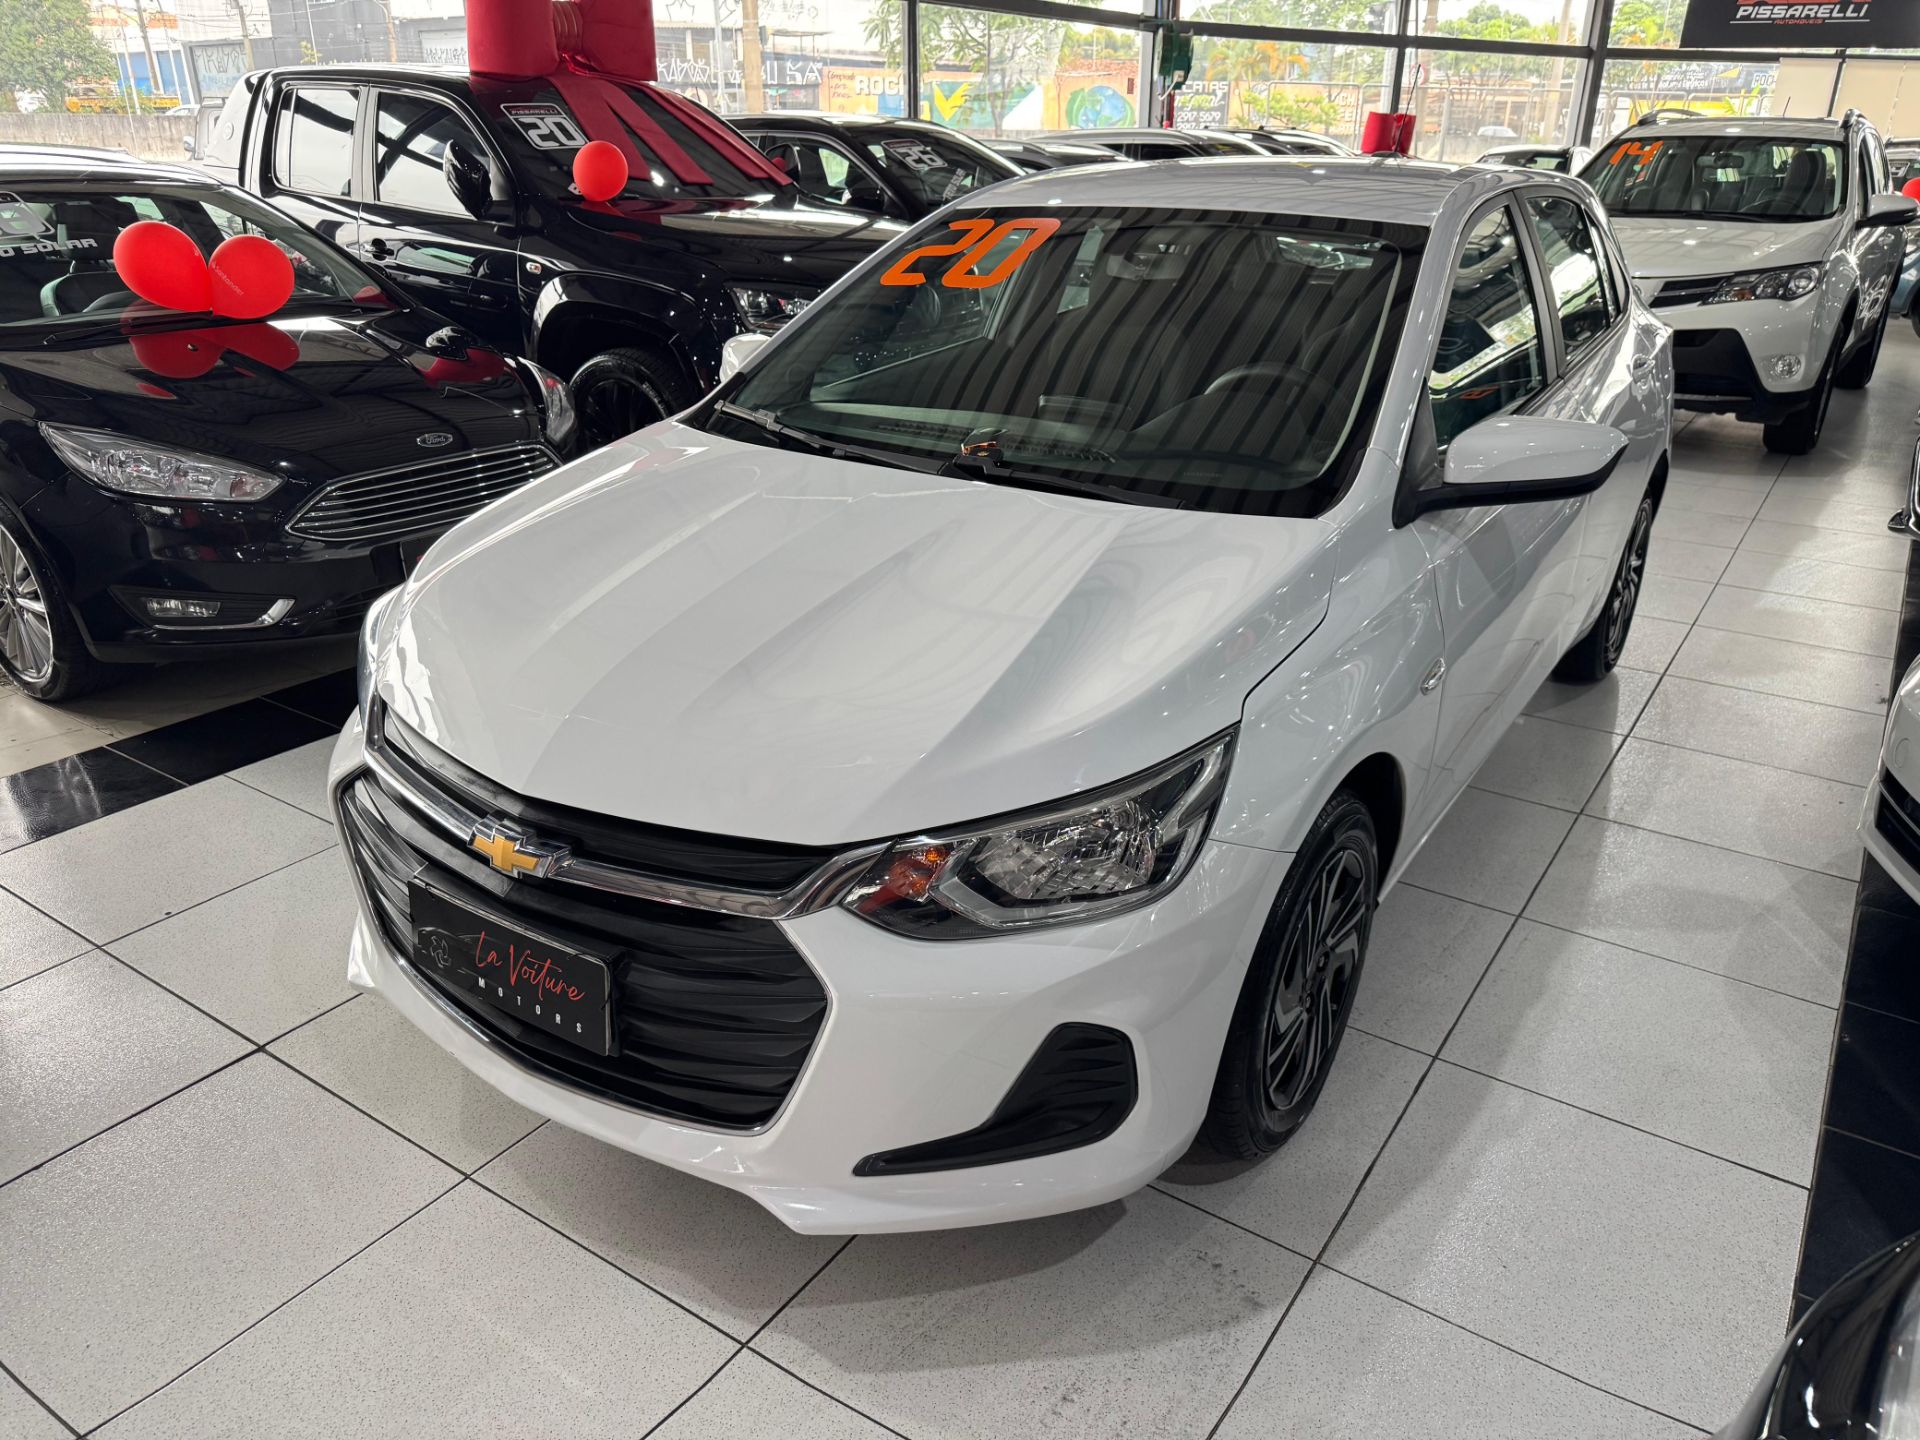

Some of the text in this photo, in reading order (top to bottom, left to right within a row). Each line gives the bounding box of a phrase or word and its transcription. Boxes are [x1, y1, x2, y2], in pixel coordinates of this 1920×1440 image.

[1735, 4, 1868, 19] PISSARELLI
[517, 117, 586, 147] 20
[893, 148, 944, 168] 26
[1609, 141, 1664, 166] 14
[20, 238, 98, 254] SOLAR
[880, 217, 1061, 289] 20
[425, 434, 446, 444] Ford
[509, 943, 586, 1001] Voiture
